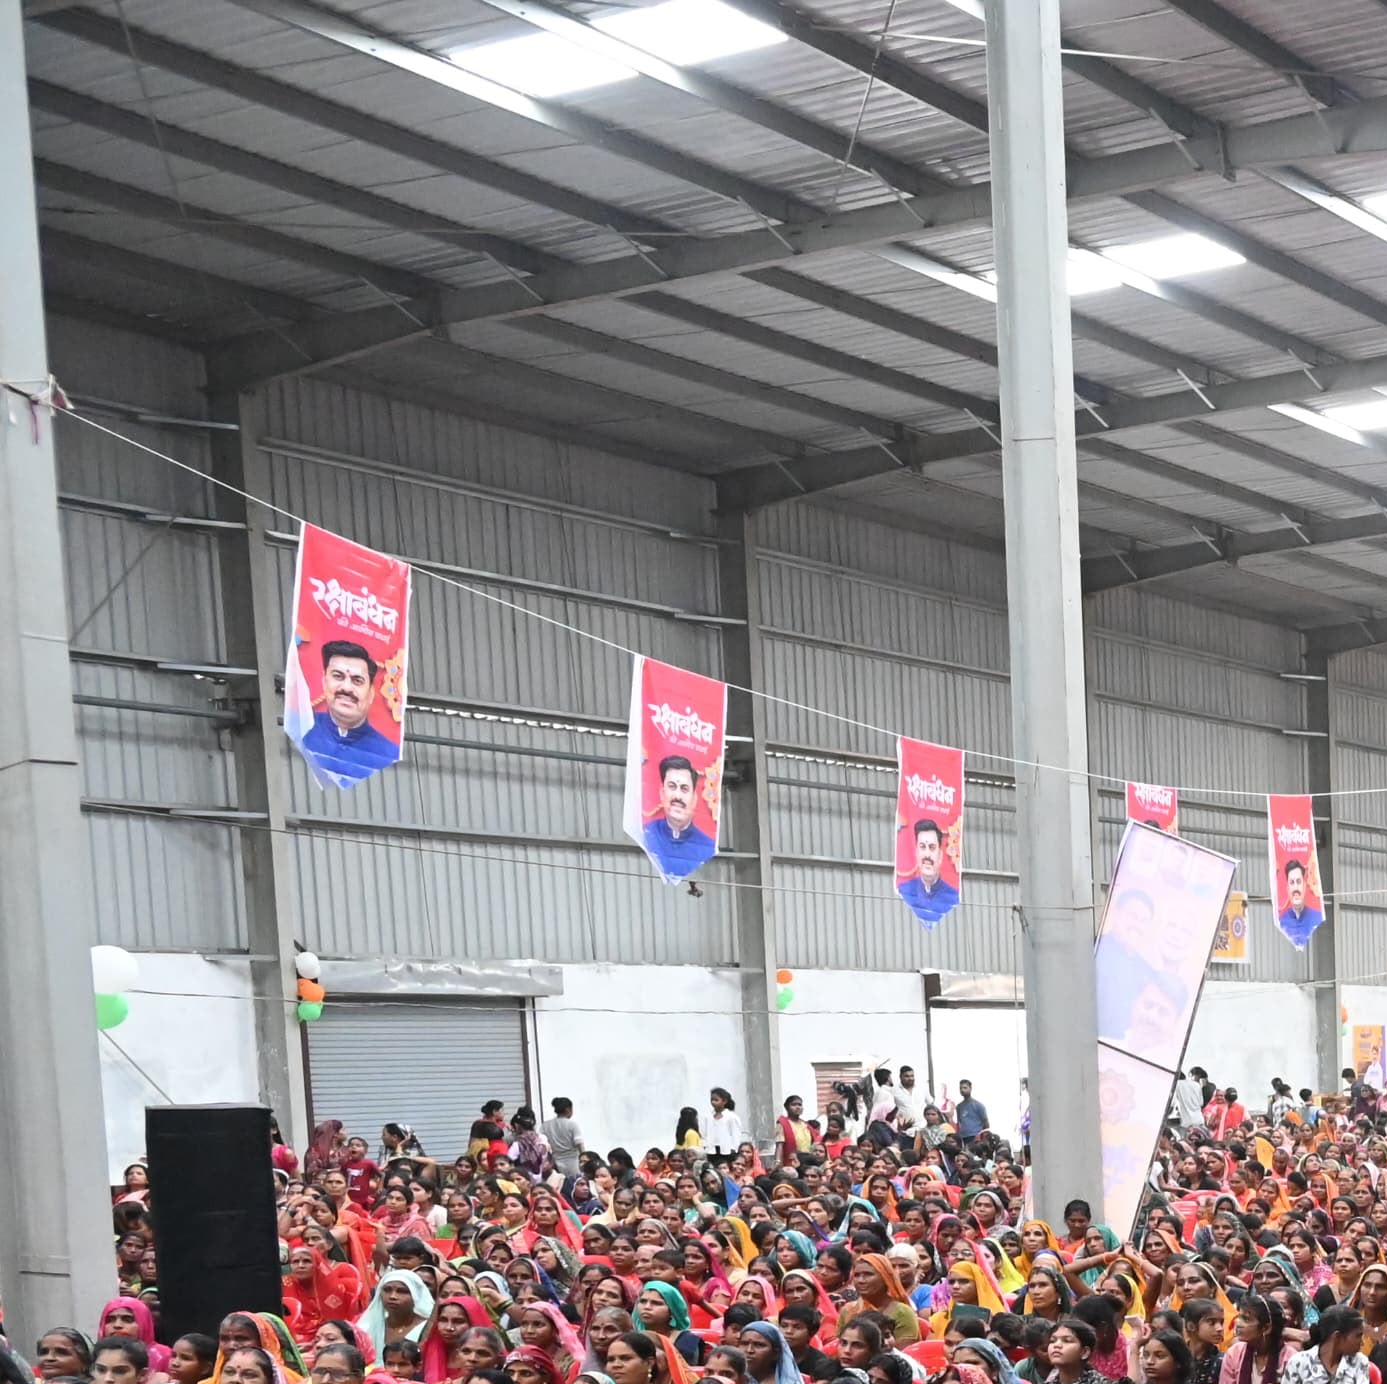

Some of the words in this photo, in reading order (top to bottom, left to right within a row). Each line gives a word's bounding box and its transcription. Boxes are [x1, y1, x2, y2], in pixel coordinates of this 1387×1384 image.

[309, 576, 399, 635] रक्षाबंधन
[647, 703, 717, 745] रक्षाबंधन
[904, 773, 956, 805] रक्षाबंधन
